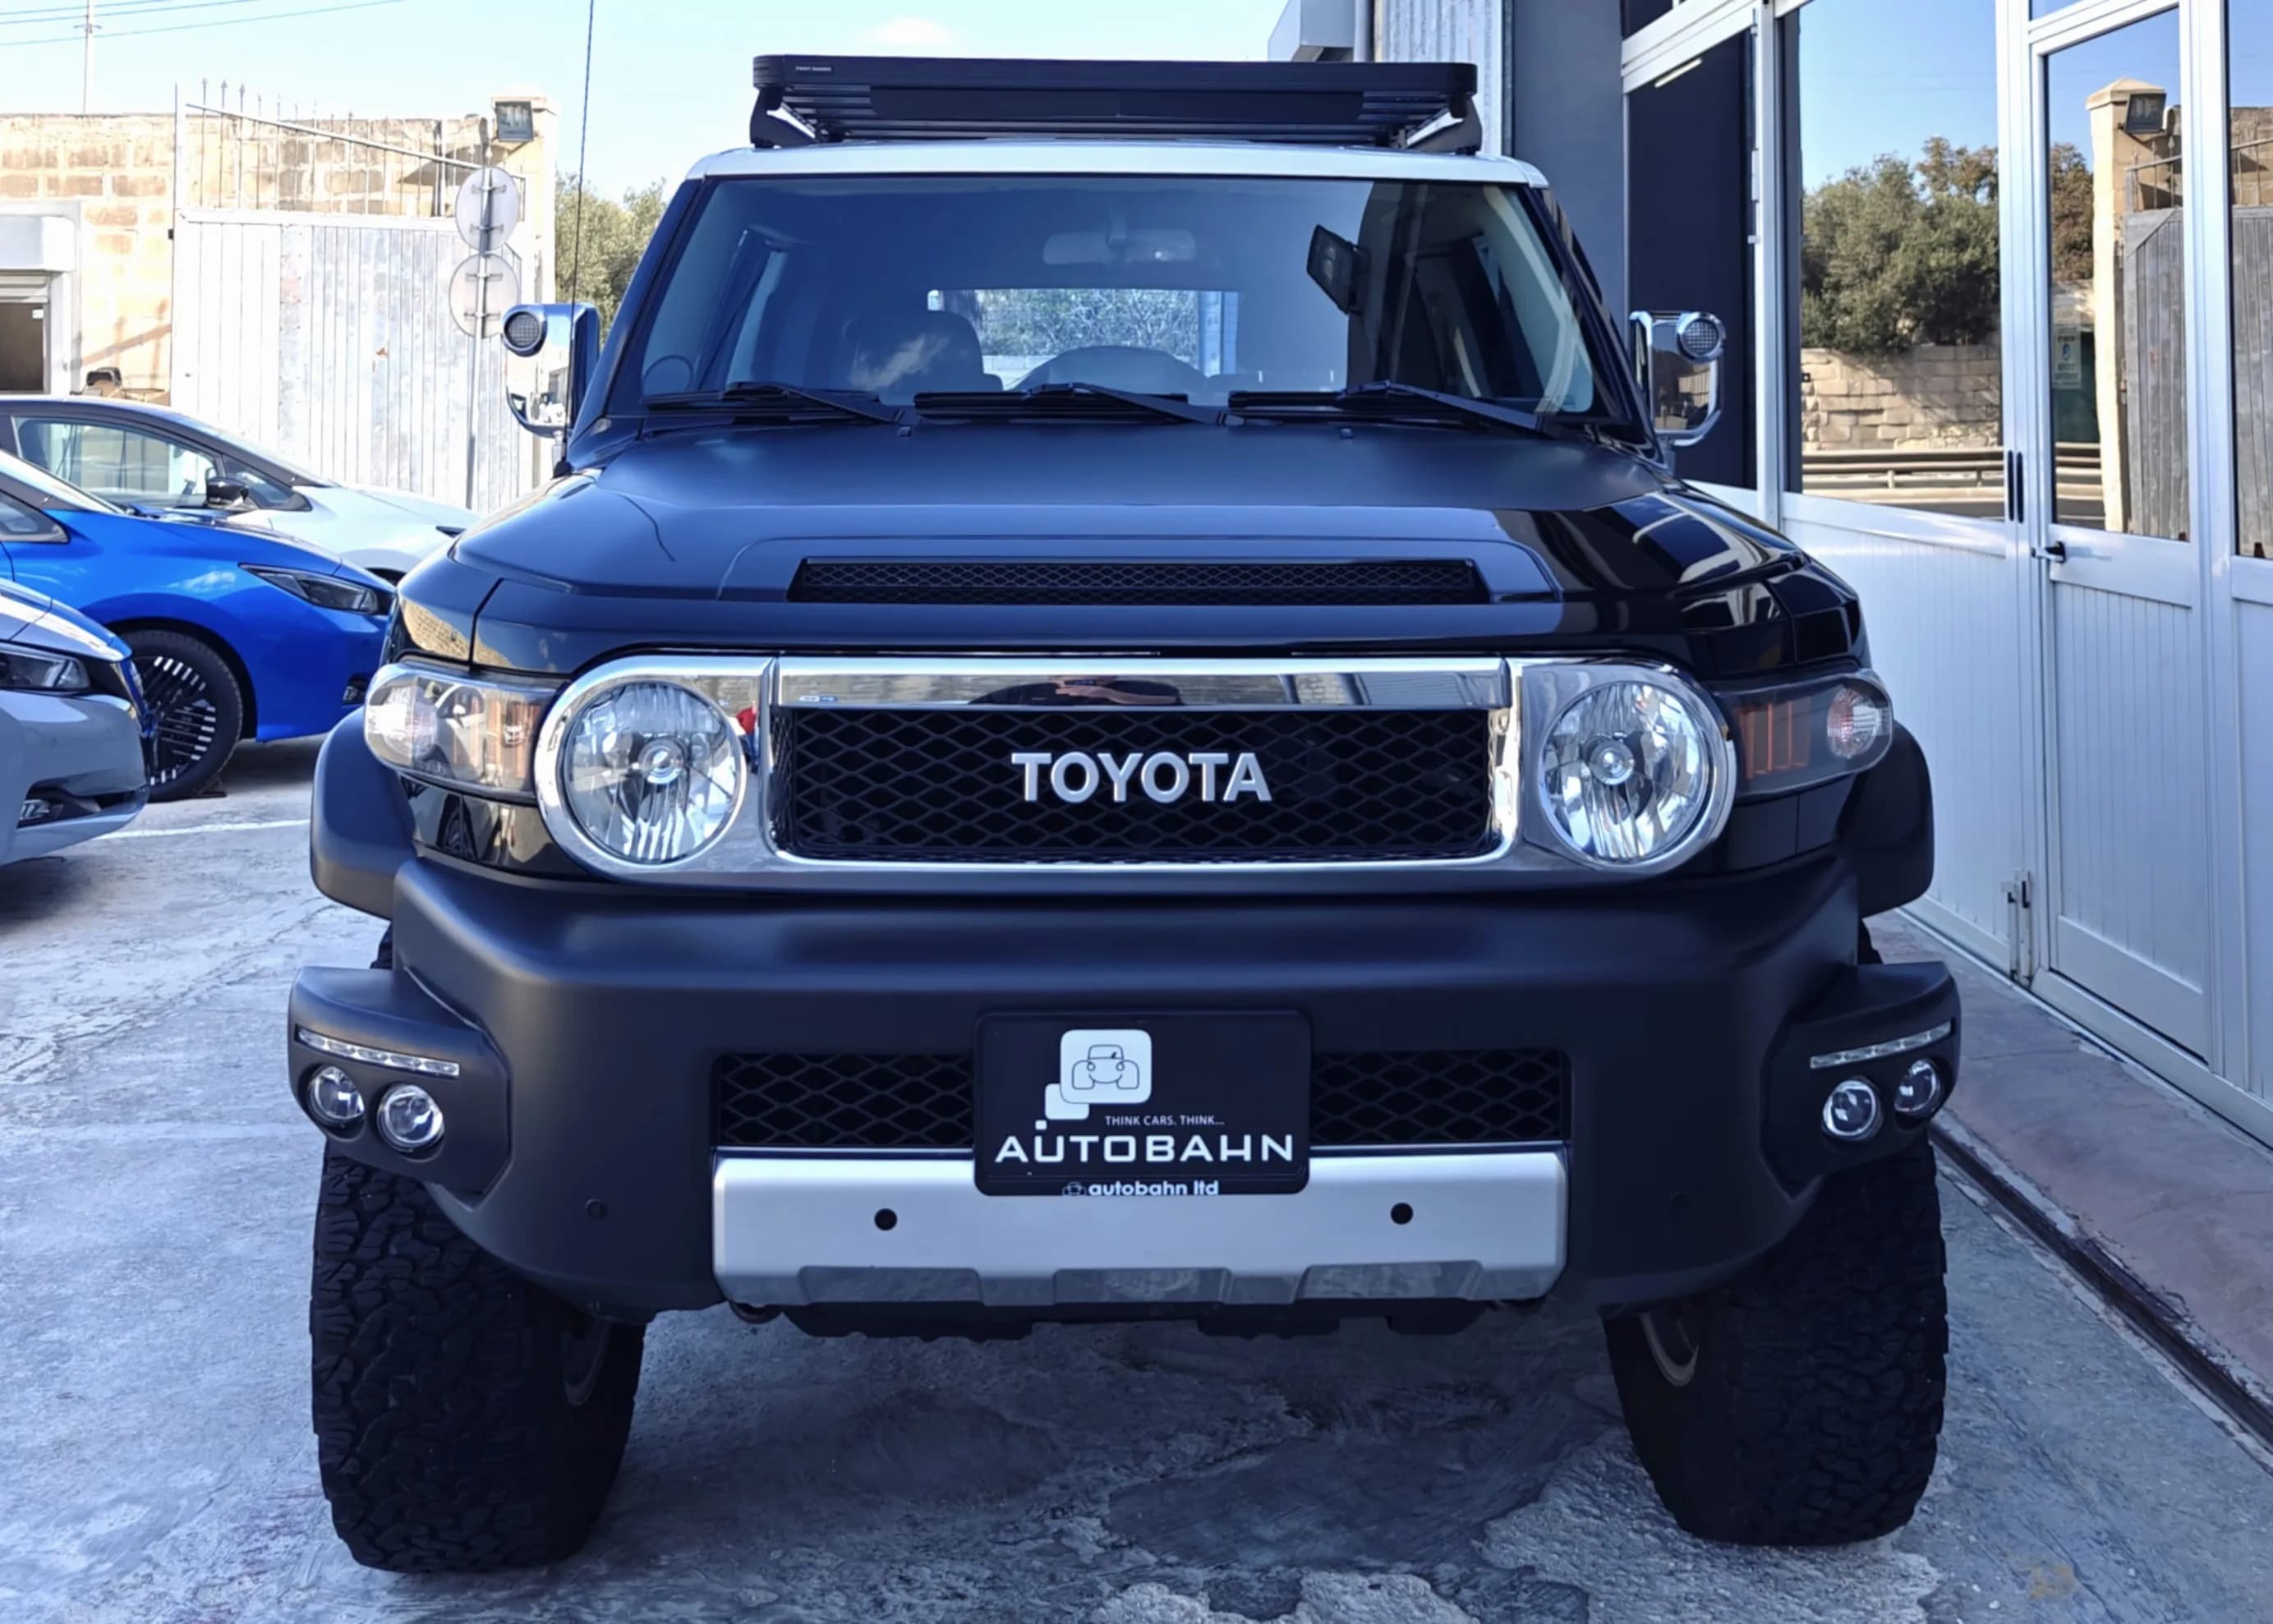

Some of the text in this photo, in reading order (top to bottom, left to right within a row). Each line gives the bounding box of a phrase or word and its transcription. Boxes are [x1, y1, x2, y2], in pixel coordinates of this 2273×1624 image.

[1011, 752, 1272, 803] TOYOTA
[1105, 1115, 1140, 1126] THINK
[1143, 1115, 1177, 1126] CARS.
[995, 1134, 1293, 1163] AUTOBAHN
[1088, 1180, 1219, 1196] autobahn ltd
